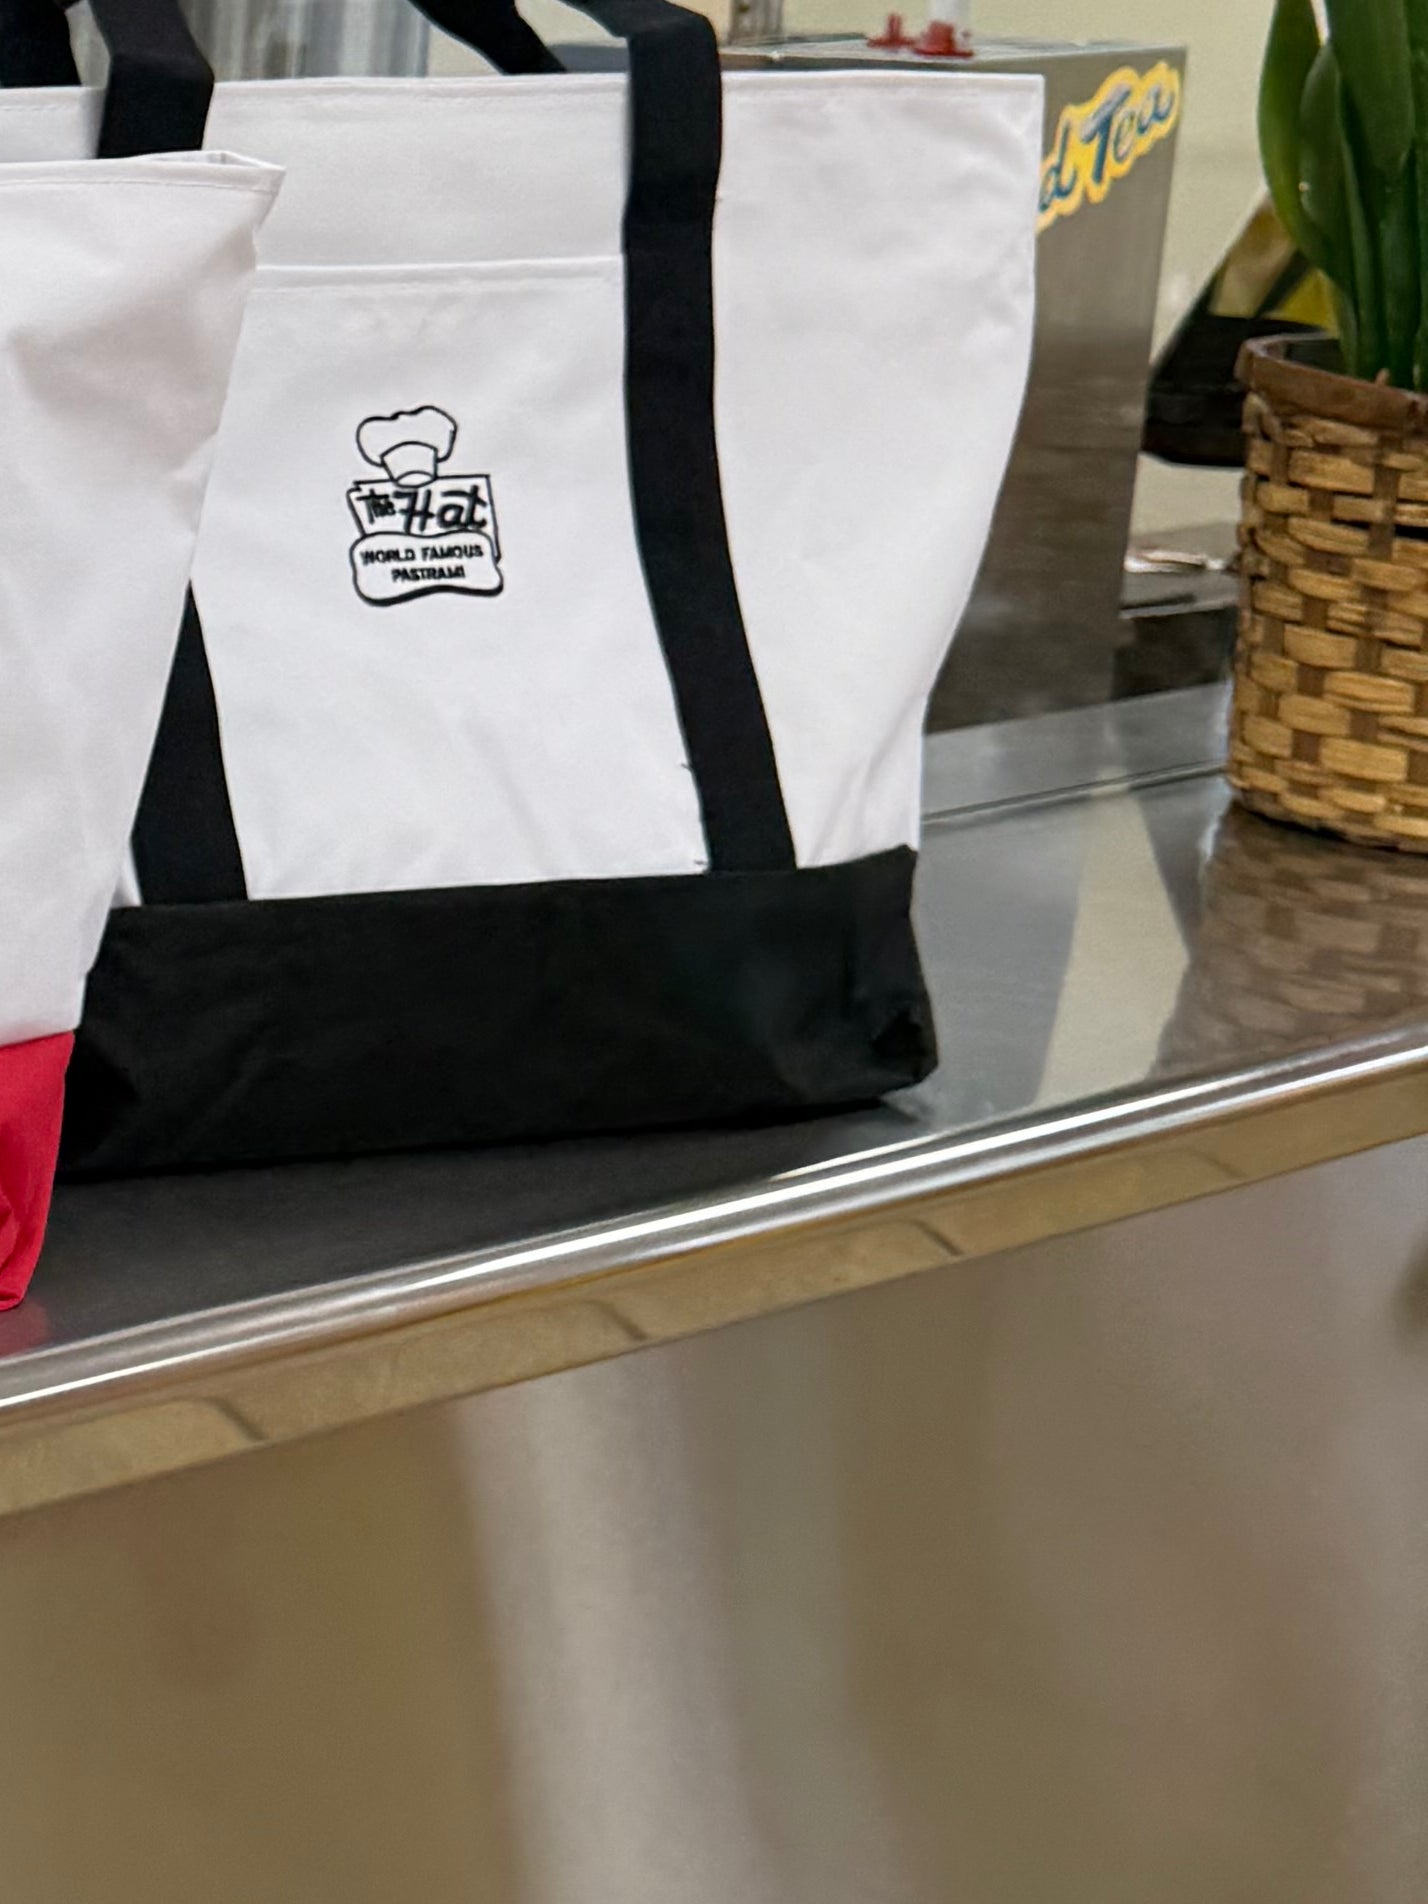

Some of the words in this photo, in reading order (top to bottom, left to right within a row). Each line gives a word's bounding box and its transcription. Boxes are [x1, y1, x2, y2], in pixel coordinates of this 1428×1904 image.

[1081, 83, 1177, 185] Tea
[356, 488, 397, 524] The
[393, 485, 488, 534] Hat
[360, 549, 416, 566] WORLD
[421, 544, 484, 562] FAMOUS
[391, 565, 465, 583] PASTRAMI
